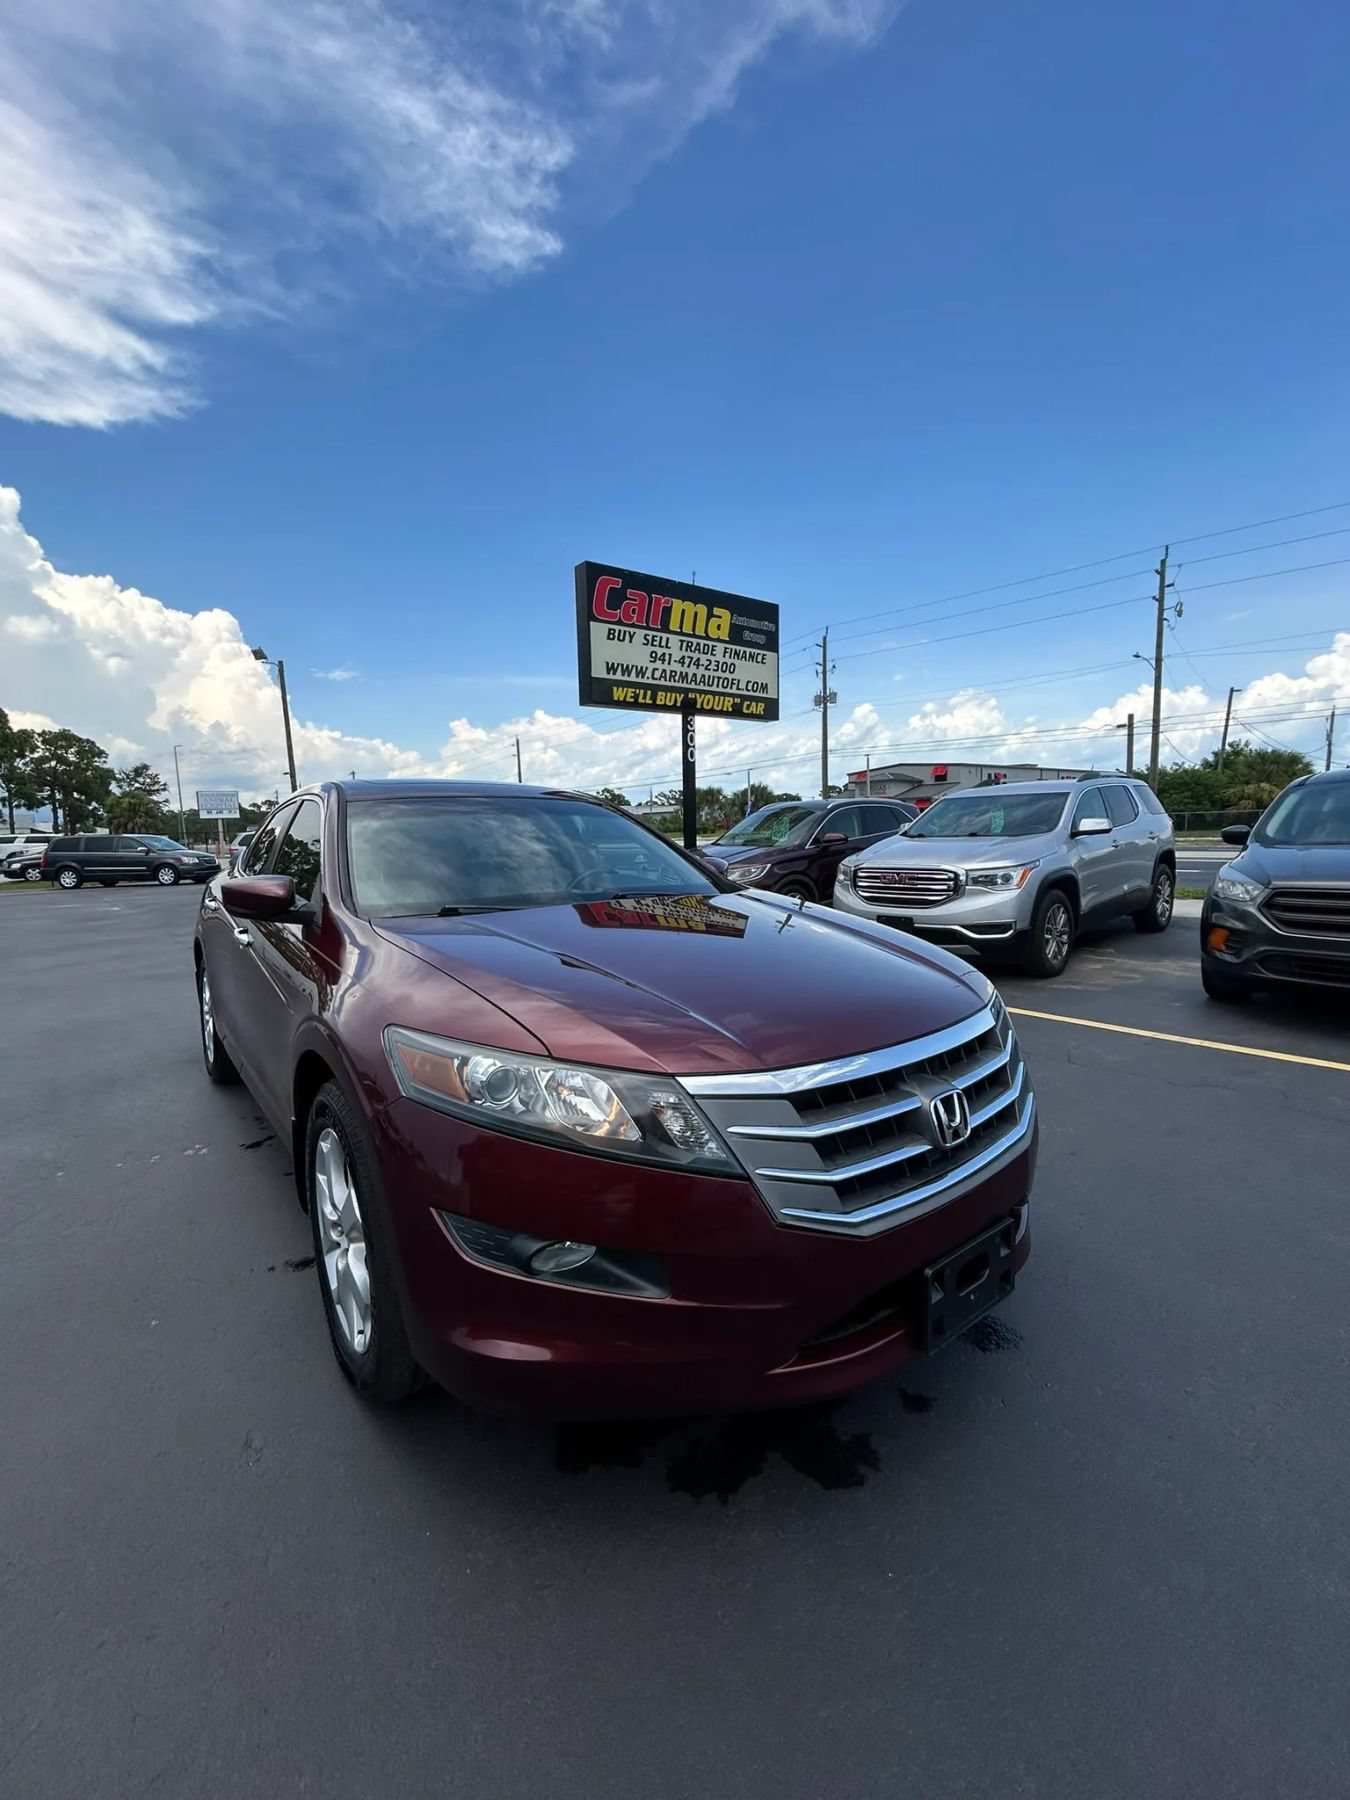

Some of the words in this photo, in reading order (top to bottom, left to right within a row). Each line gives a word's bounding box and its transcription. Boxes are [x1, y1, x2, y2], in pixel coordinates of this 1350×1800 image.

[593, 576, 731, 641] Carma
[606, 628, 636, 644] BUY
[643, 633, 671, 650] SELL
[678, 639, 717, 657] TRADE
[722, 647, 767, 665] FINANCE
[605, 661, 769, 695] WWW.CARMAAUTOFL.COM
[649, 650, 736, 675] 941-474-2300
[612, 686, 653, 704] WE'LL
[656, 690, 685, 707] BUY
[742, 701, 764, 715] CAR
[880, 873, 918, 885] GMC
